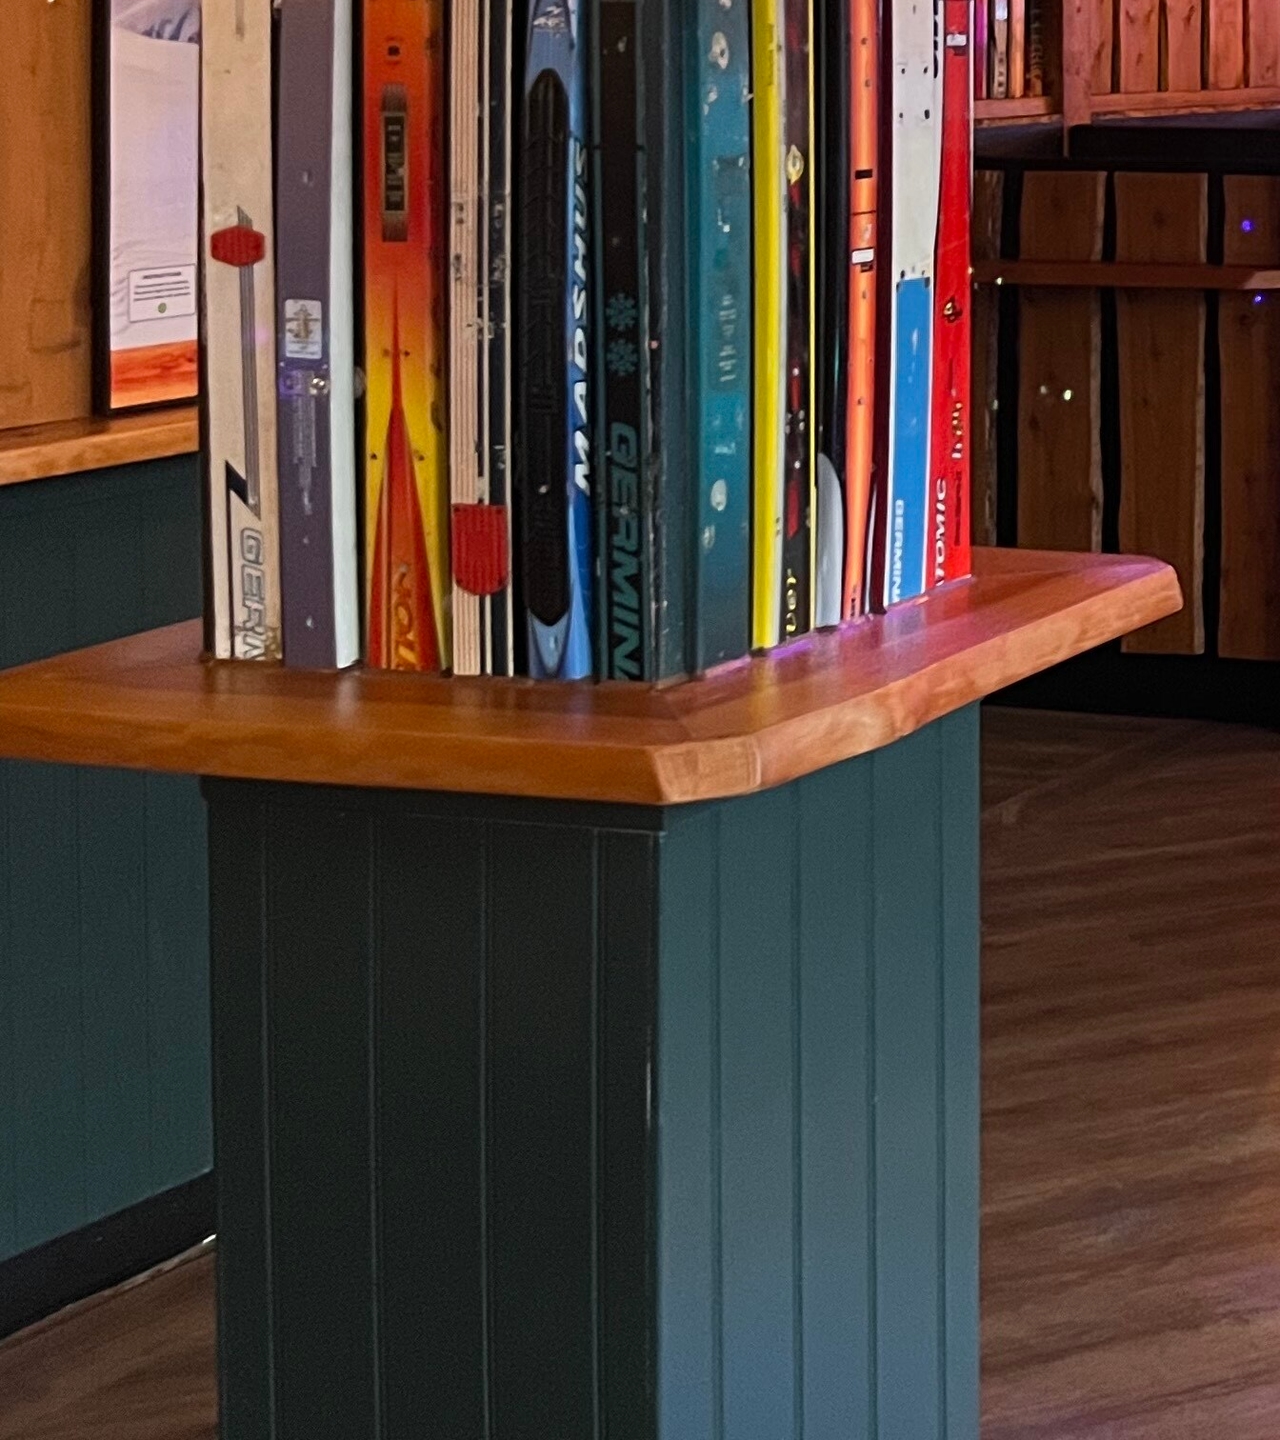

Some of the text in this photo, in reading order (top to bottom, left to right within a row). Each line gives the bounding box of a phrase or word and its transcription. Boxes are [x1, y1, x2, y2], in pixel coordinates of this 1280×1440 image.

[570, 137, 591, 497] MADSHUS
[610, 421, 642, 680] GERMIN
[892, 499, 905, 604] GERMIN
